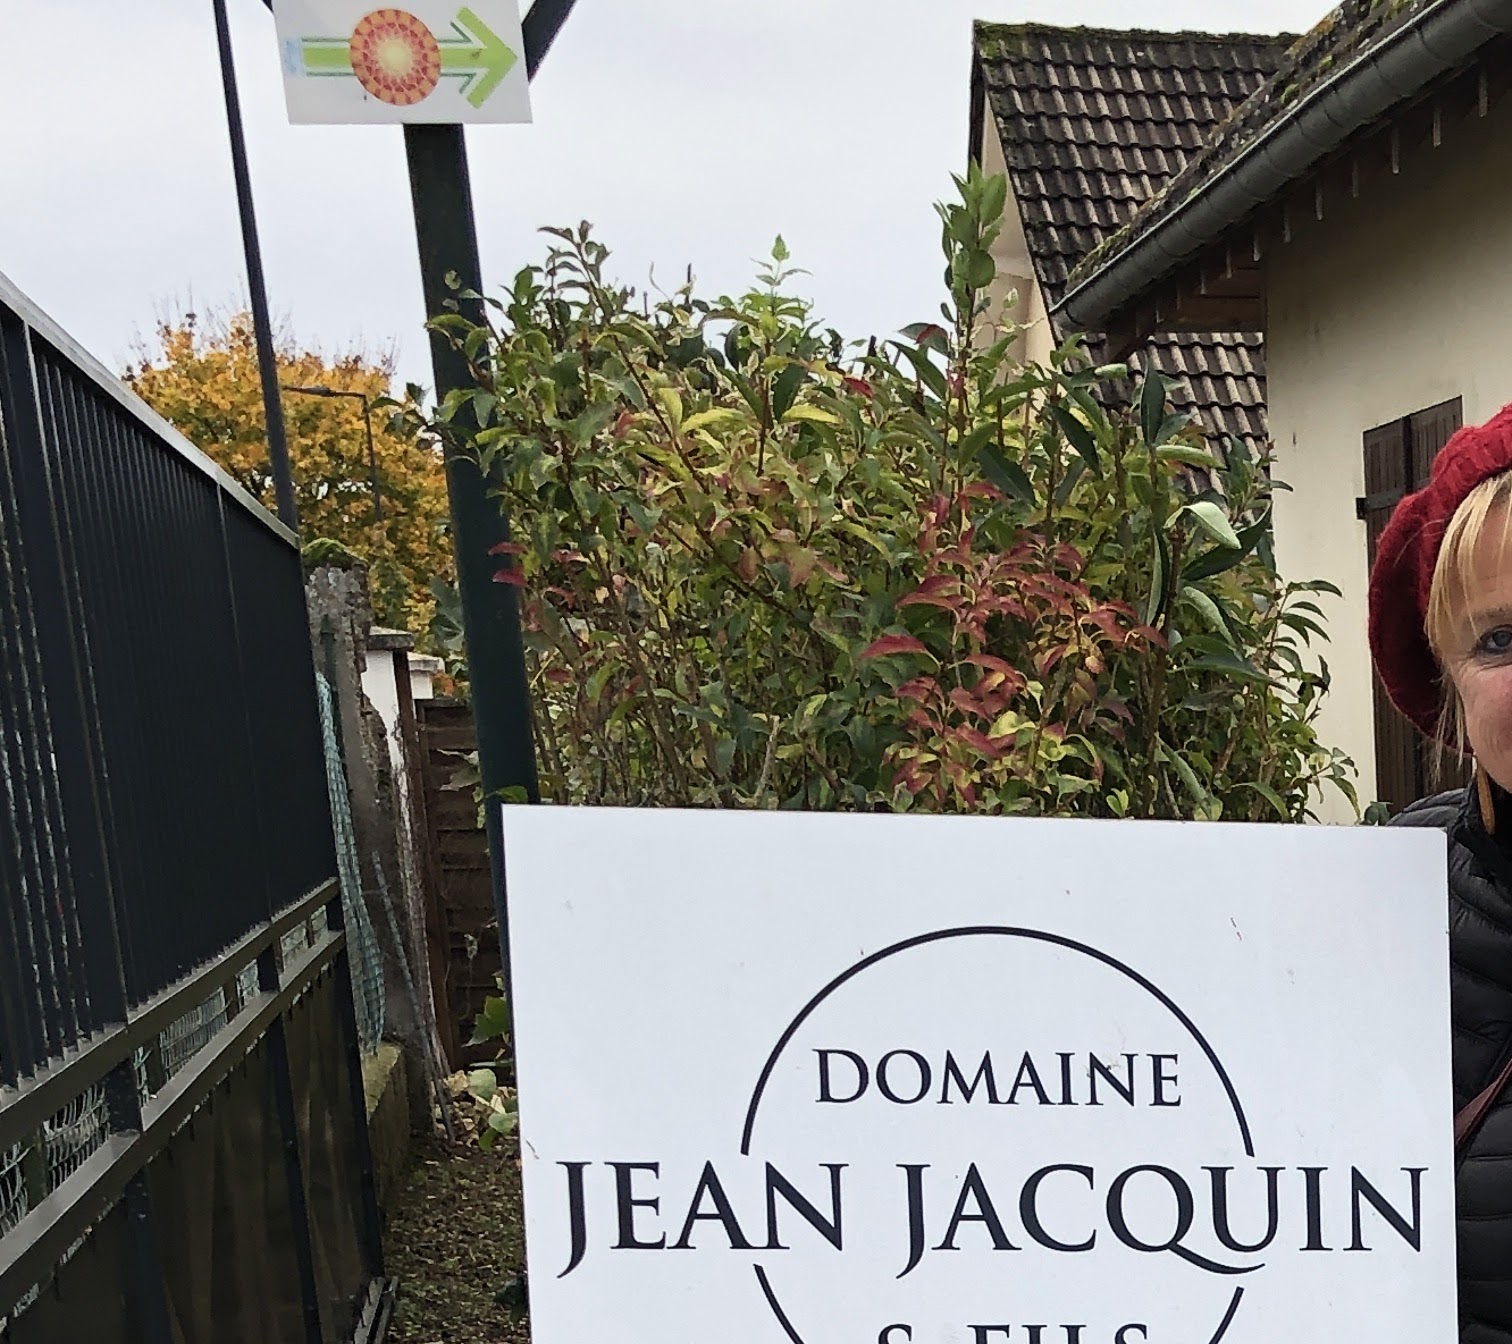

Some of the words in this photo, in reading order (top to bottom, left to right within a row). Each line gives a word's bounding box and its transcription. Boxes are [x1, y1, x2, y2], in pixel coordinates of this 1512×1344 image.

[813, 1049, 1181, 1106] DOMAINE
[556, 1160, 848, 1278] JEAN
[896, 1163, 1428, 1279] JACQUIN
